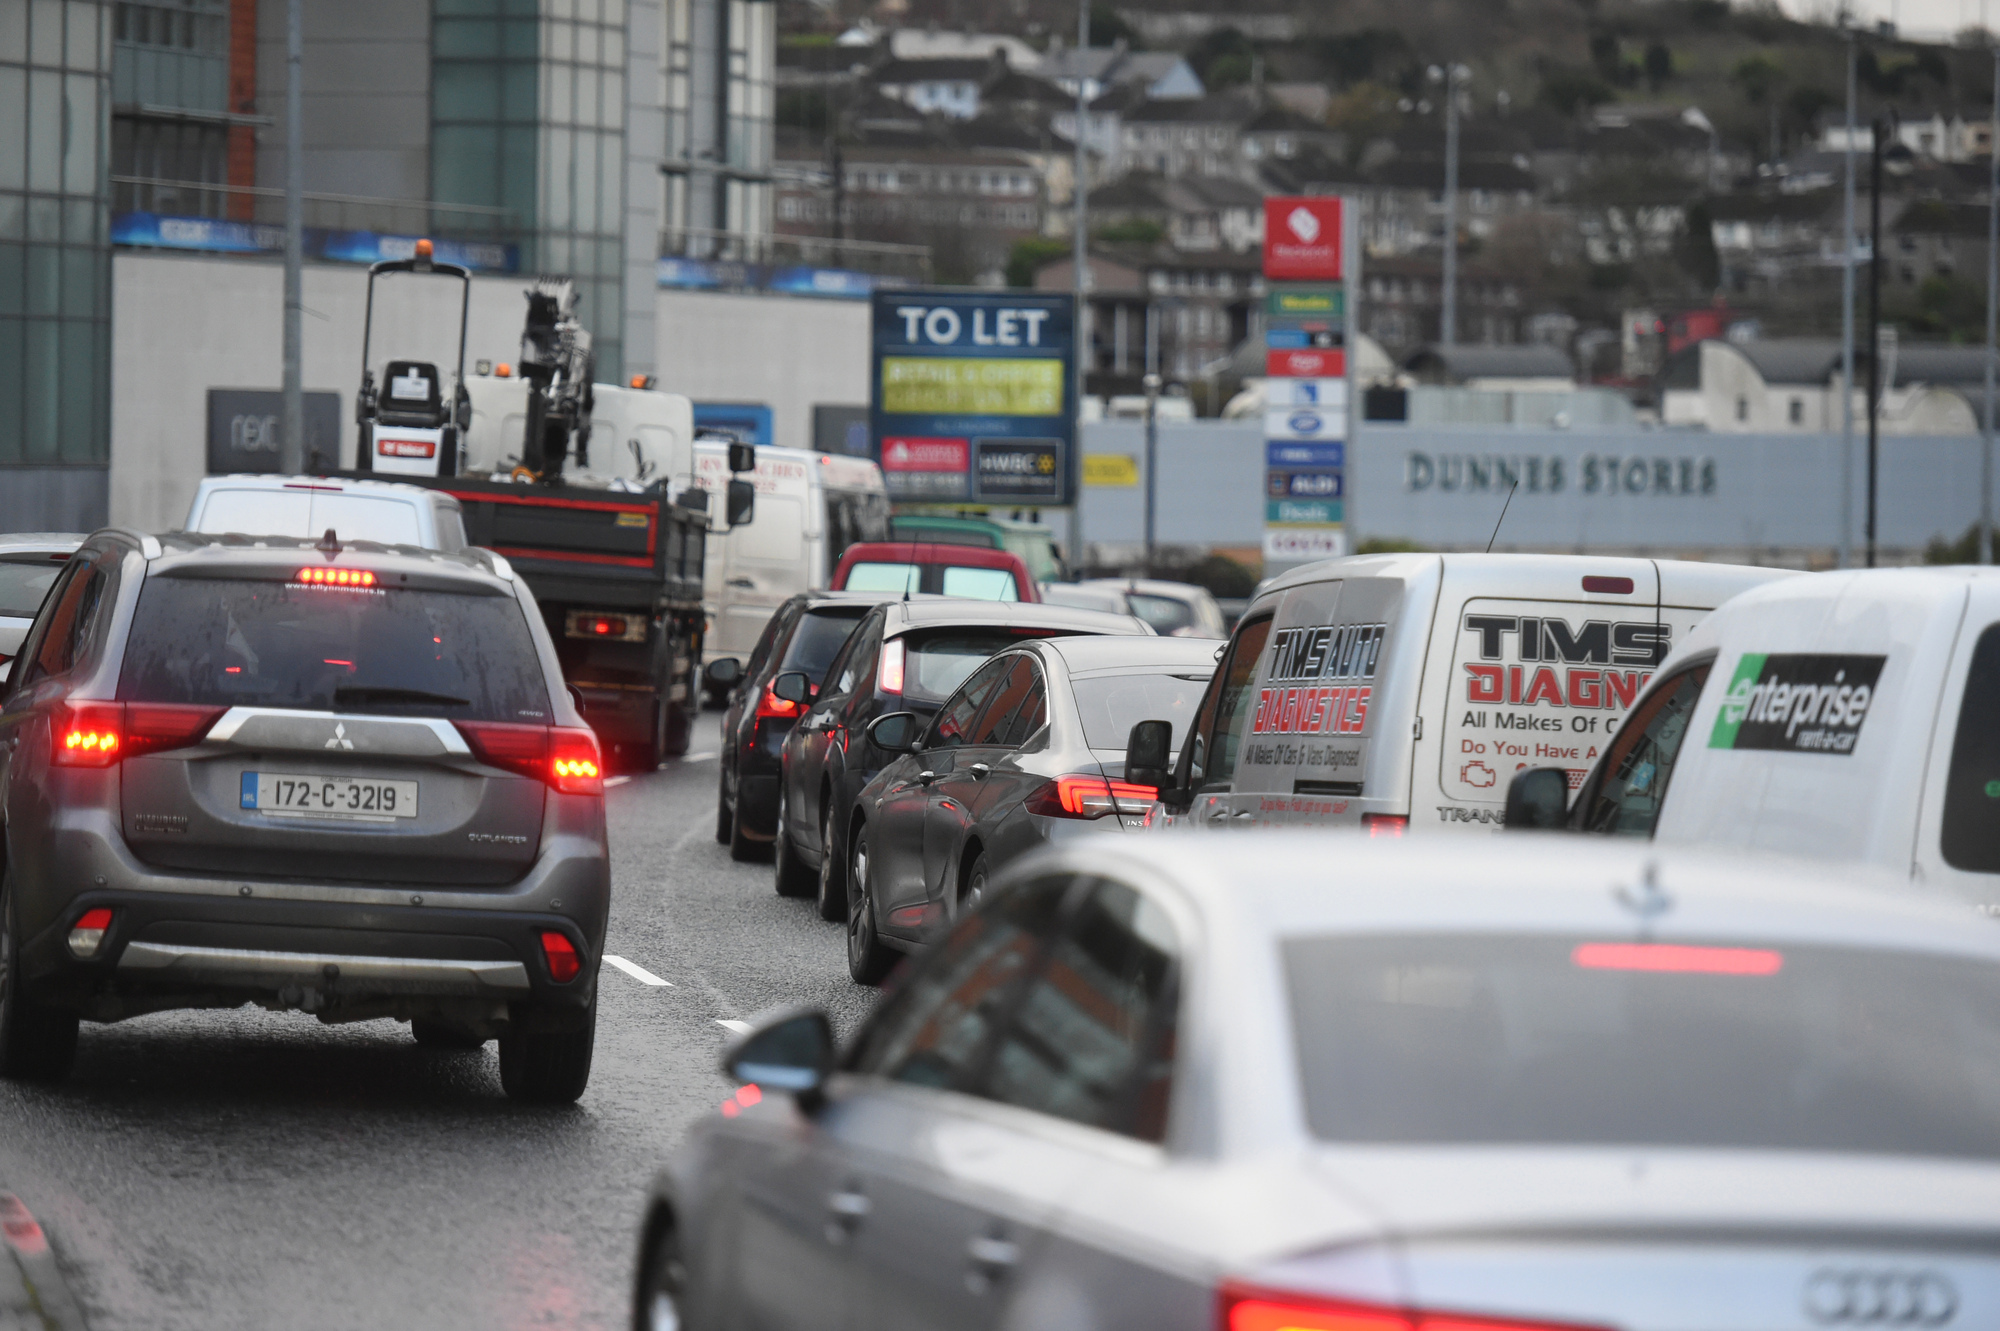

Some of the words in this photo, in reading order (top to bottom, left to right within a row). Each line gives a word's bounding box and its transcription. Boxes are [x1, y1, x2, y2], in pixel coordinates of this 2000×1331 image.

[897, 306, 962, 344] TO
[972, 308, 1049, 346] LET
[1290, 473, 1340, 495] ALDI
[1403, 451, 1567, 493] DUNNES
[1578, 453, 1717, 494] STORES
[284, 582, 386, 595] www.oflynnmotors.ie
[1267, 626, 1334, 683] TIMS
[1321, 621, 1387, 681] AUTO
[1464, 614, 1673, 669] TIMS
[1463, 662, 1656, 710] DIAGN
[518, 709, 544, 718] 4WD
[1252, 684, 1373, 736] DIAGNOSTICS
[1722, 669, 1872, 739] enterprise
[1461, 711, 1487, 728] All
[1494, 712, 1563, 732] Makes
[1570, 716, 1598, 734] Of
[1461, 739, 1487, 754] Do
[1493, 740, 1529, 756] You
[1535, 743, 1580, 759] Have
[1586, 746, 1598, 760] A
[1795, 728, 1857, 750] rent-a-car
[1254, 744, 1274, 765] Makes
[1284, 744, 1299, 766] Cars
[1324, 744, 1362, 771] Diagnosed
[243, 793, 255, 802] IRL
[274, 780, 396, 812] 172-C-3219
[468, 833, 528, 843] OUTLANDER
